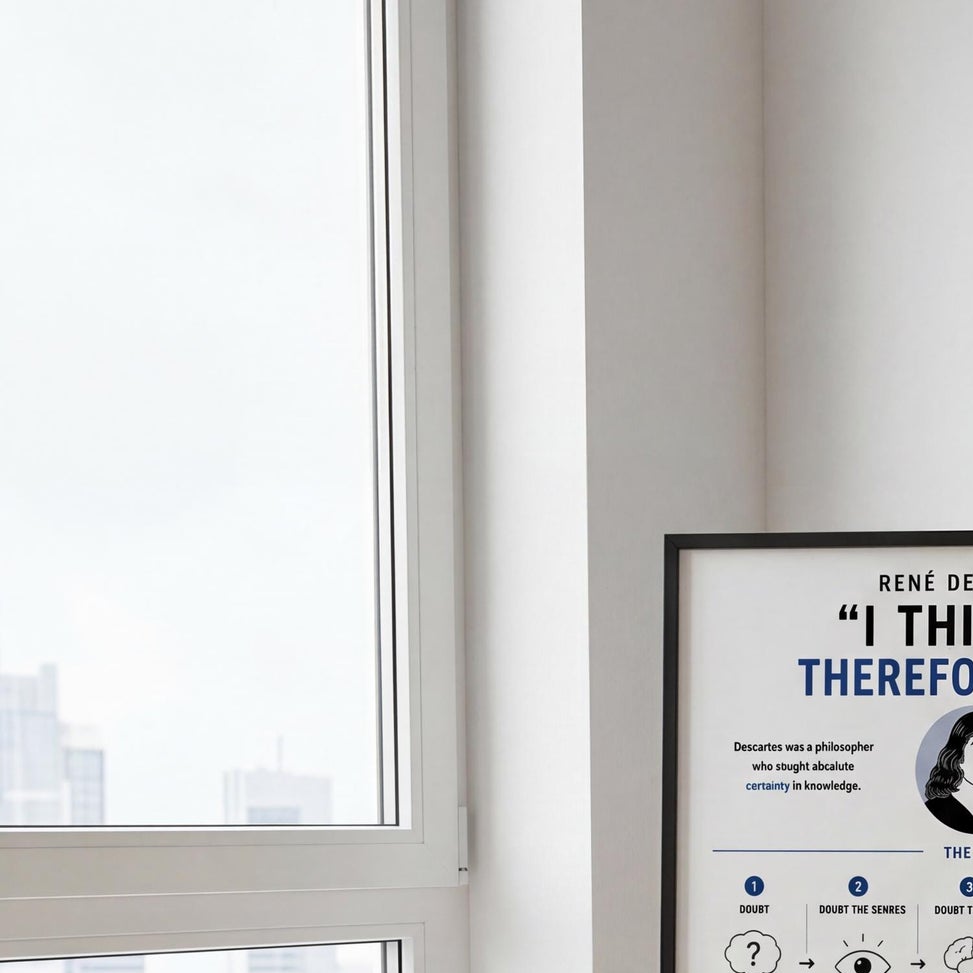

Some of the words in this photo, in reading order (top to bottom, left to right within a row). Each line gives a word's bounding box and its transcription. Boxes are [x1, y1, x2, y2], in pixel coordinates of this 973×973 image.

[879, 570, 935, 591] RENÉ
[839, 604, 874, 646] “I
[734, 742, 783, 751] Descartes
[815, 741, 874, 755] philosopher
[752, 761, 773, 771] who
[746, 781, 790, 793] certainty
[792, 780, 802, 790] in
[804, 780, 861, 793] knowledge.
[943, 847, 971, 858] THE
[751, 881, 757, 892] 1
[855, 881, 862, 892] 2
[966, 882, 973, 892] 3
[739, 905, 770, 913] DOUBT
[819, 905, 849, 914] DOUBT
[851, 905, 869, 914] THE
[934, 906, 965, 914] DOUBT
